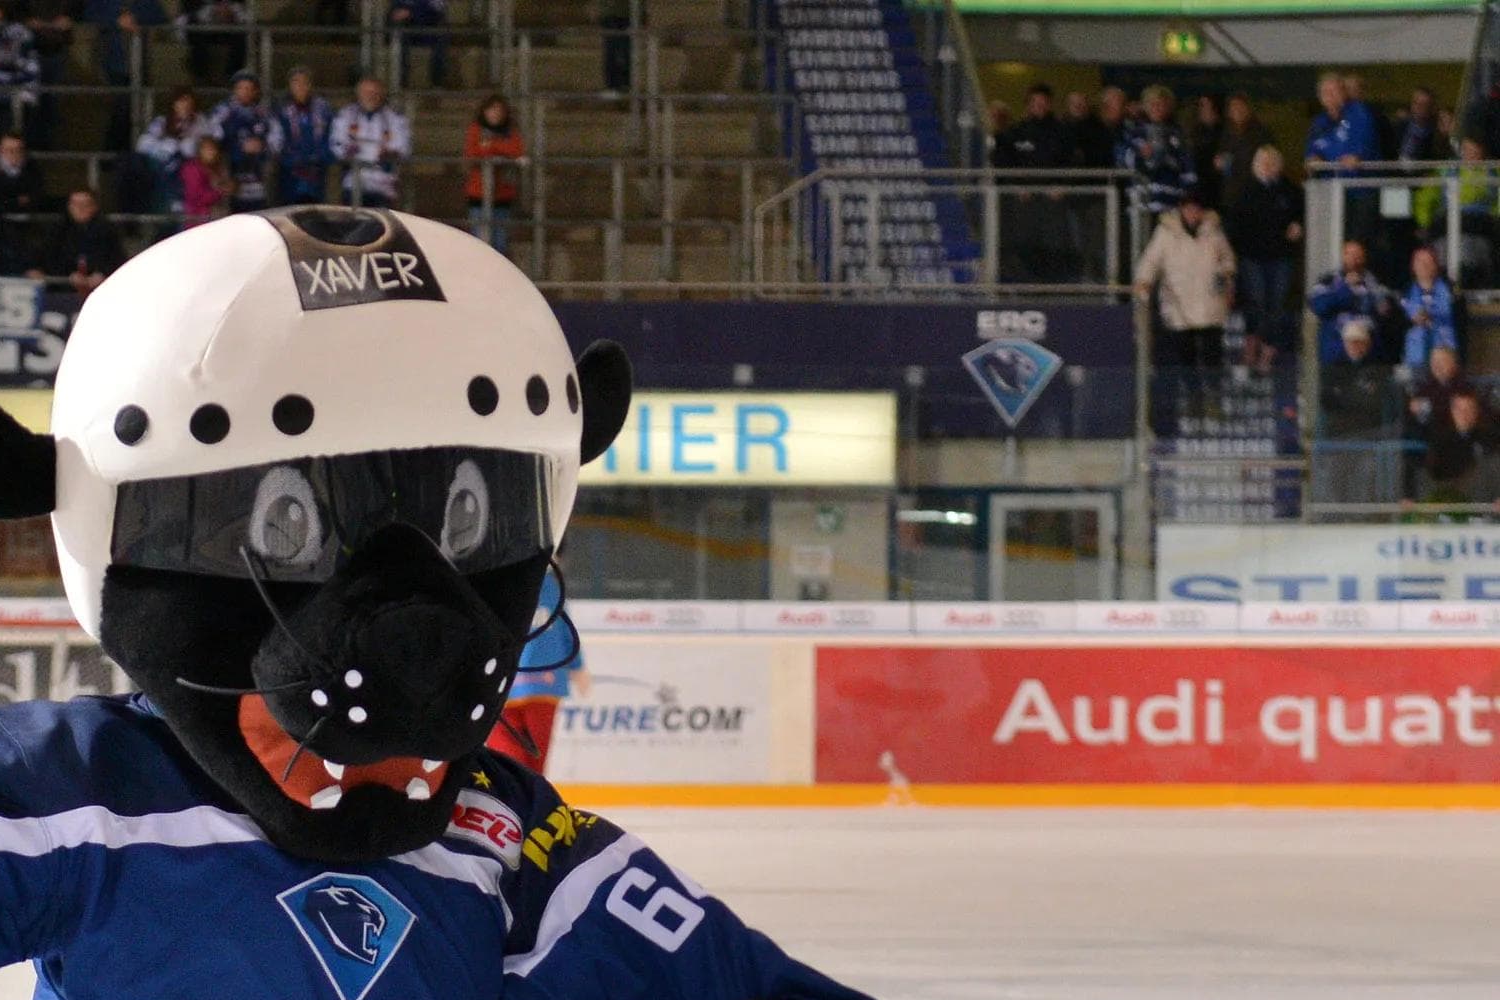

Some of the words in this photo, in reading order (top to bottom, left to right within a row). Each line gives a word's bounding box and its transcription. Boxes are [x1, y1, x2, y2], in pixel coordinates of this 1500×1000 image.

[300, 252, 423, 295] XAVER
[1106, 610, 1157, 624] Audi
[1267, 610, 1319, 624] Audi
[1428, 610, 1478, 624] Audi
[993, 678, 1224, 746] Audi
[1259, 685, 1500, 763] quat
